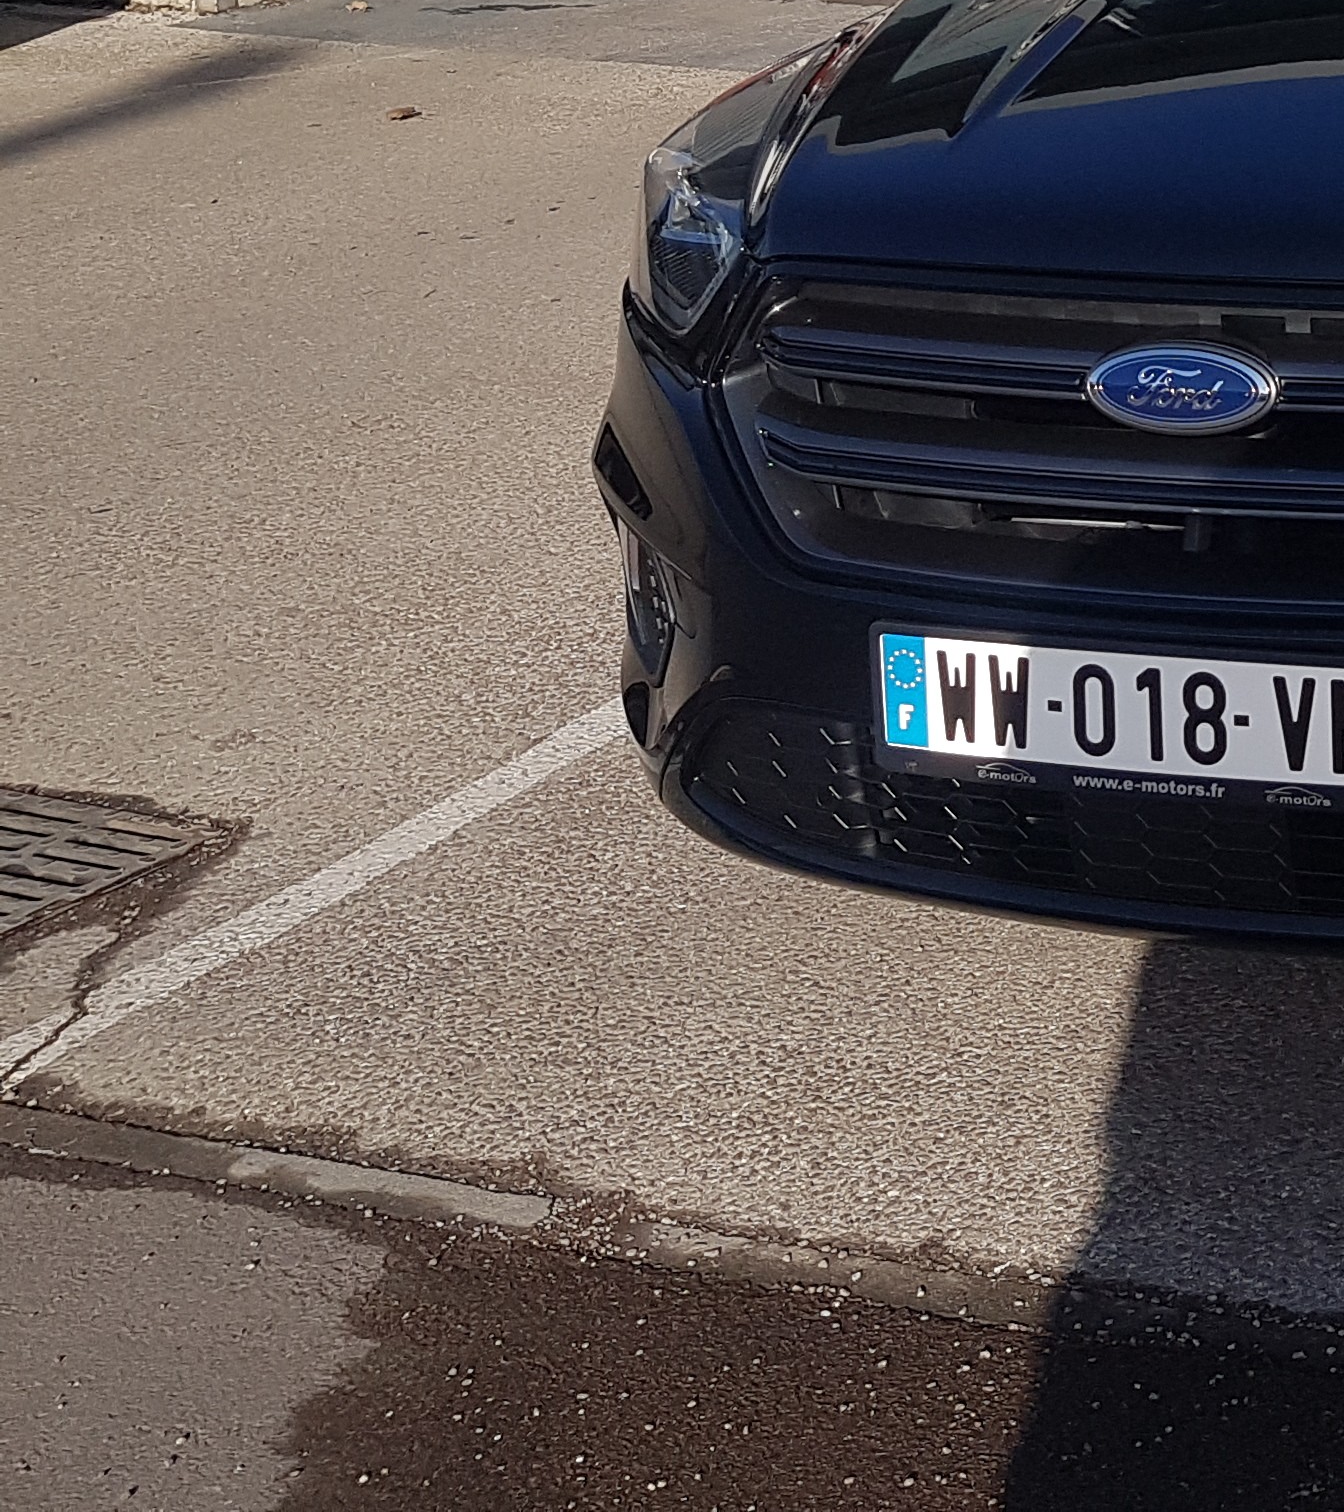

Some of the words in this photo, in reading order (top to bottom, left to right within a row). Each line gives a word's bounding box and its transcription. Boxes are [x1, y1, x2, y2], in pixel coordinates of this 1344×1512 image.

[1127, 365, 1224, 410] Ford
[898, 703, 914, 730] F
[1072, 774, 1226, 798] www.e-motors.fr
